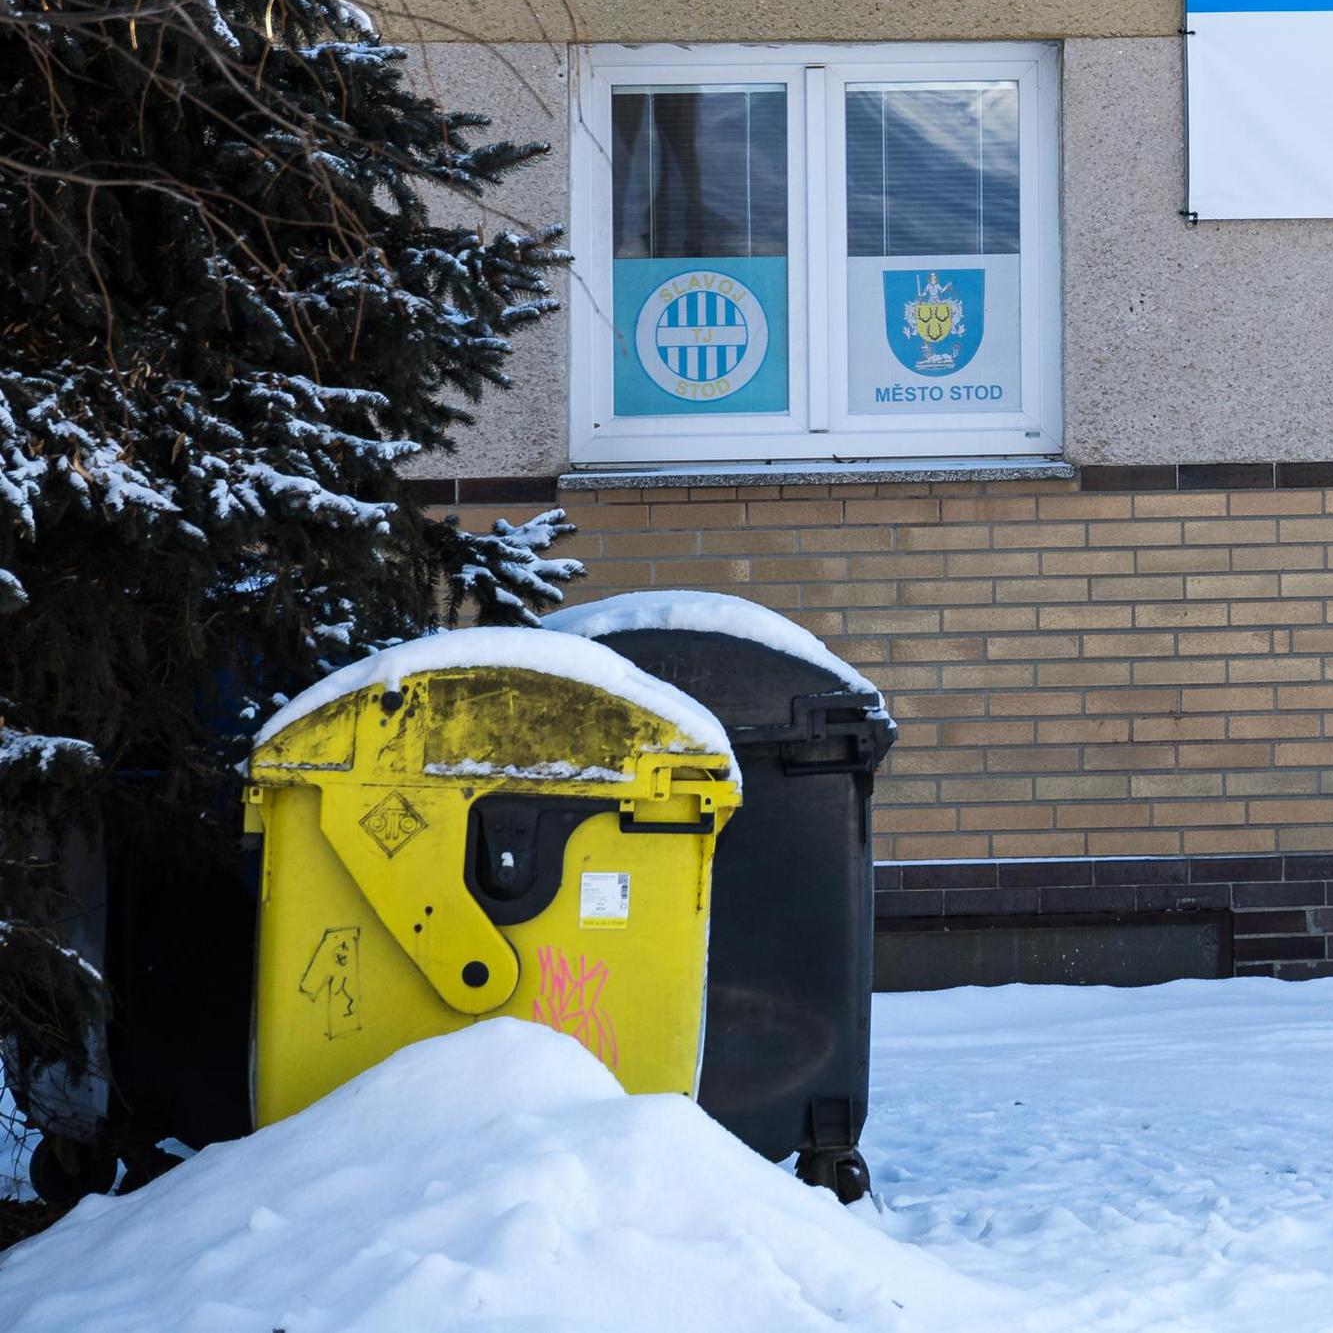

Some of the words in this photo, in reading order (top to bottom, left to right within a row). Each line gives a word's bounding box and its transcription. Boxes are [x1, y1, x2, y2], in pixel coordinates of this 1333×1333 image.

[659, 272, 745, 304] SLAVOJ
[691, 328, 713, 344] TJ
[675, 379, 732, 398] STOD
[875, 381, 943, 403] MĚSTO
[949, 384, 1003, 402] STOD
